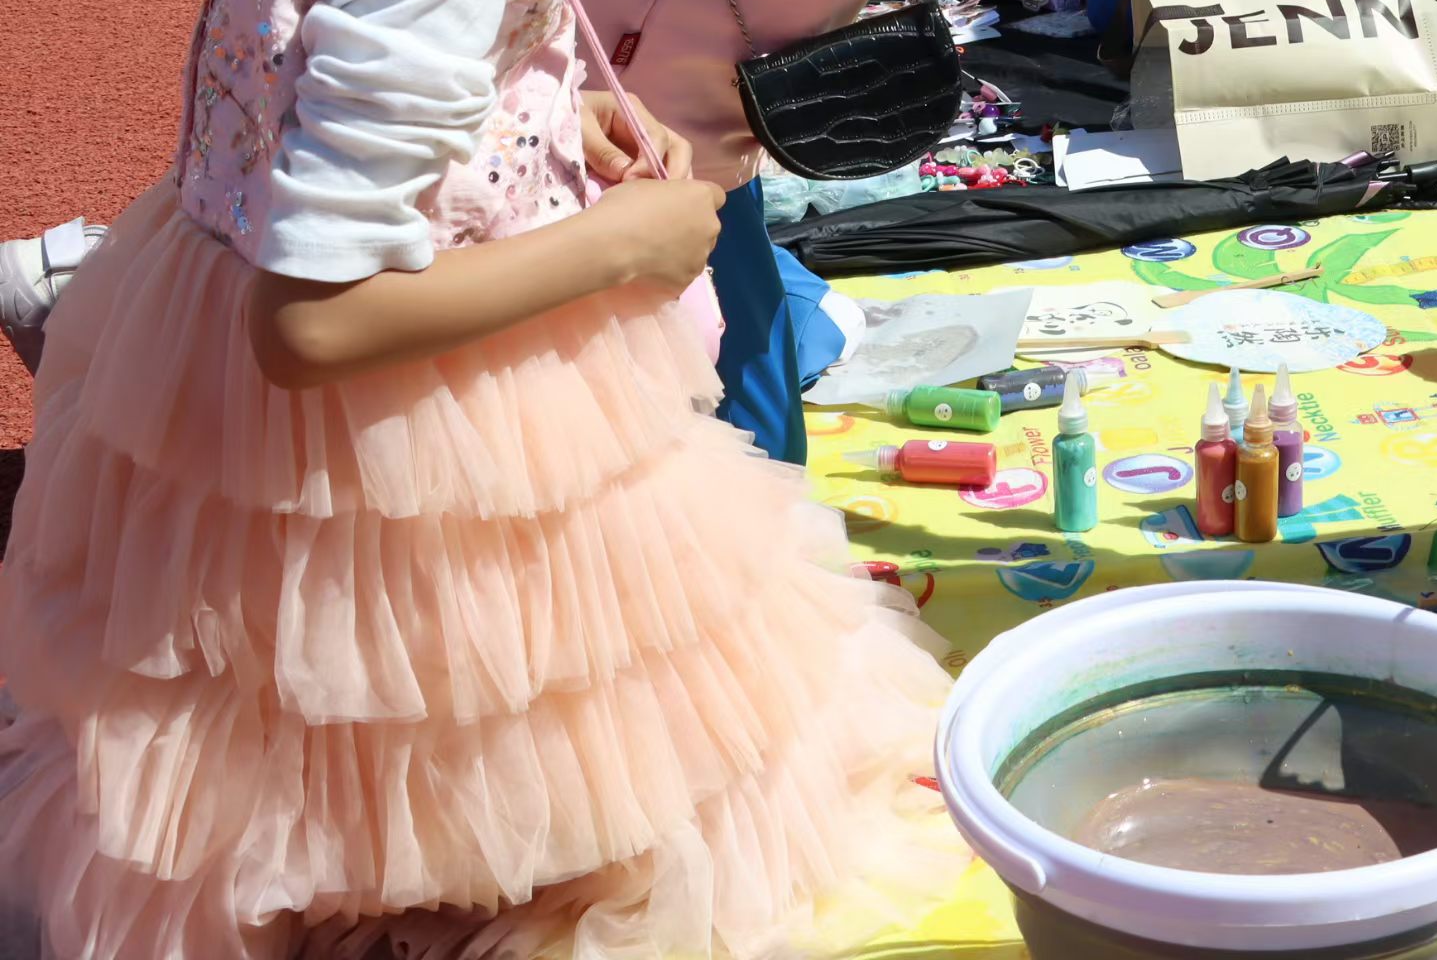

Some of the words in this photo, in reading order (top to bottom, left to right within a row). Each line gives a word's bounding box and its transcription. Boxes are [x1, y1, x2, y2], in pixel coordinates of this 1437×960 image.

[1297, 392, 1341, 442] Necktie
[1021, 426, 1052, 467] Flower
[1115, 465, 1182, 481] J
